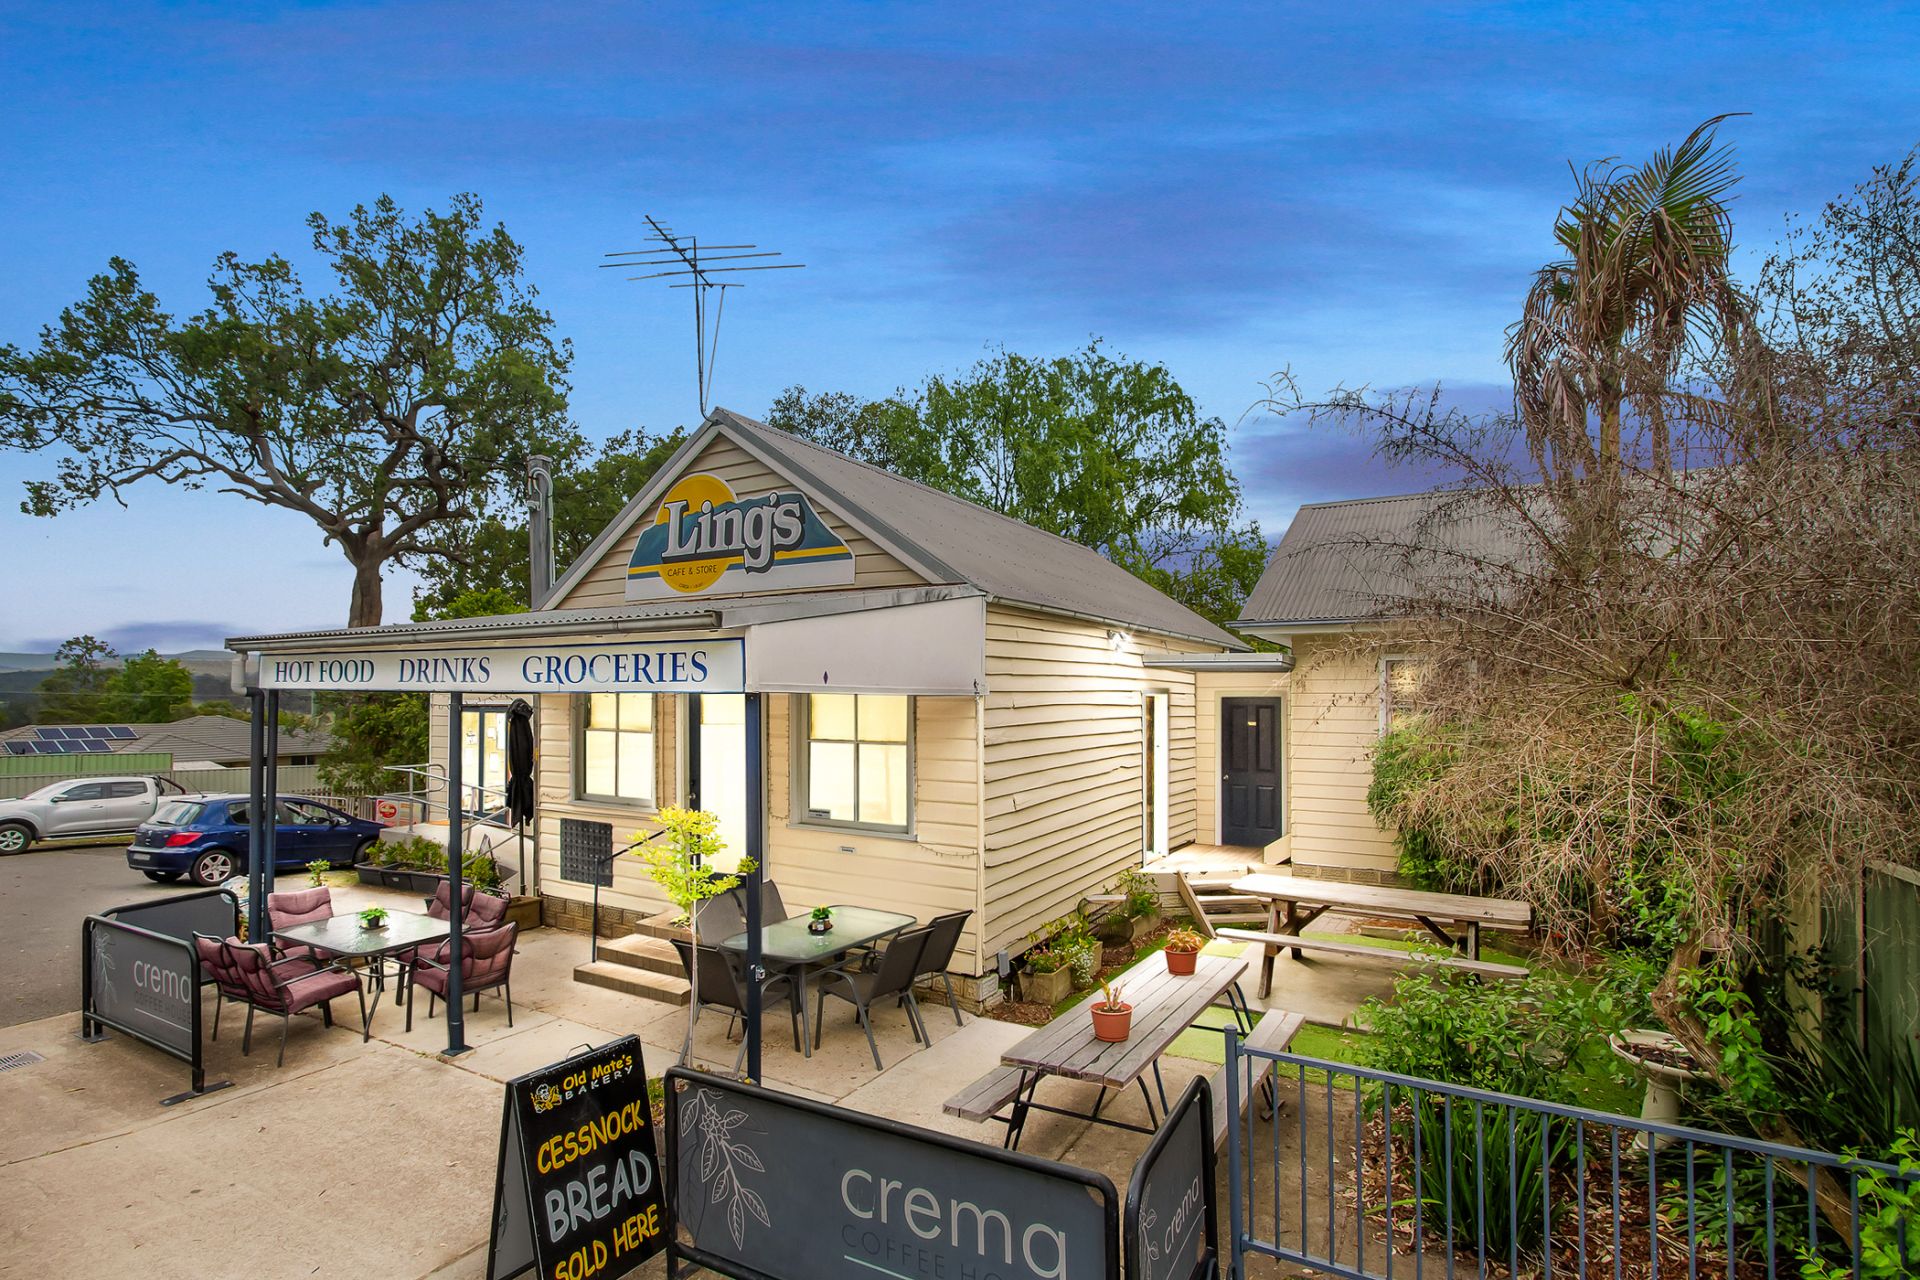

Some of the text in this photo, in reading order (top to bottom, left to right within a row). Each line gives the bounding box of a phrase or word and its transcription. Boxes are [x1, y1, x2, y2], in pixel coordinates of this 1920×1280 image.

[661, 493, 802, 569] Ling's
[667, 564, 717, 577] CAFE & STORE
[275, 650, 709, 685] HOT FOOD DRINKS GROCERIES
[134, 960, 192, 1004] crema
[563, 1054, 632, 1091] Old Mate's
[565, 1065, 633, 1100] BAKERY
[537, 1100, 645, 1174] CESSNOCK
[545, 1150, 652, 1243] BREAD
[841, 1168, 1068, 1280] crema
[1164, 1175, 1199, 1255] crema
[555, 1203, 660, 1280] SOLD HERE
[841, 1224, 945, 1279] COFFEE
